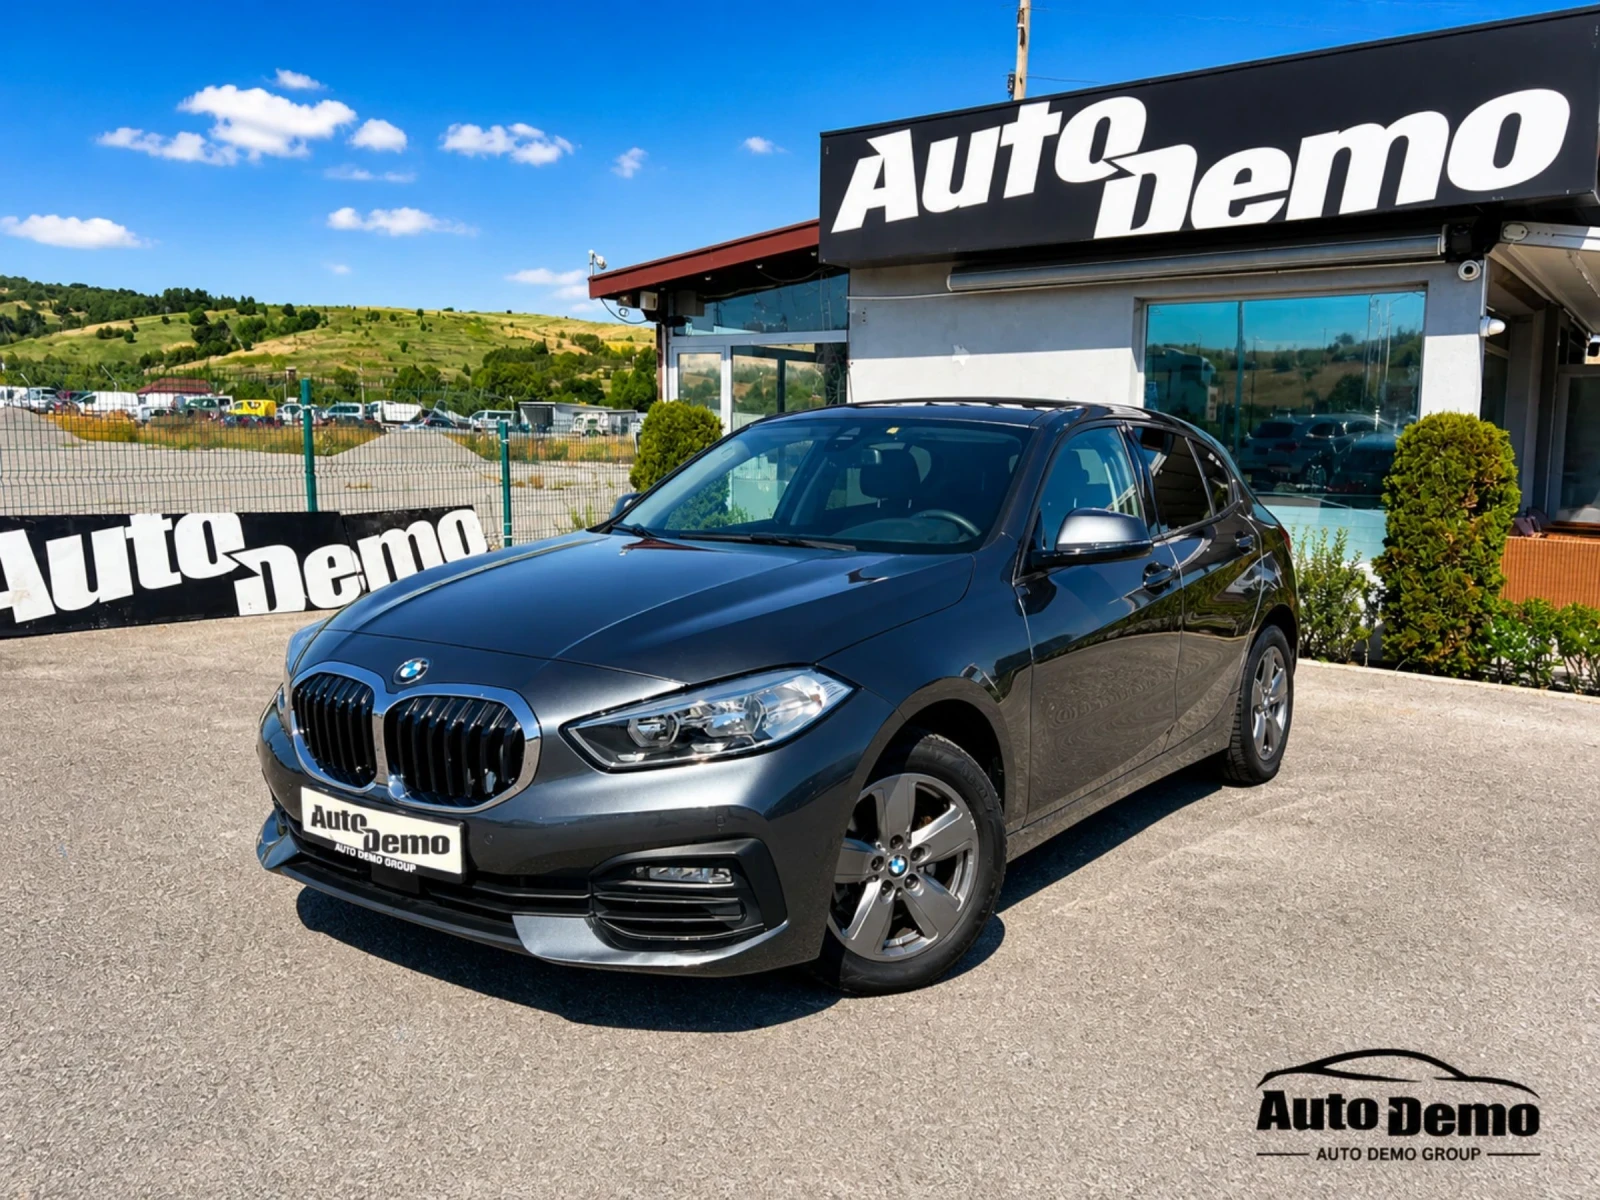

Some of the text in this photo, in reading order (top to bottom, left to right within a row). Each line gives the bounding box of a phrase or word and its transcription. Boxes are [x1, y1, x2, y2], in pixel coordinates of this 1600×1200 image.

[831, 88, 1571, 239] Auto Demo
[230, 509, 488, 616] Demo
[311, 804, 451, 855] Auto Demo
[334, 843, 417, 873] AUTO DEMO GROUP
